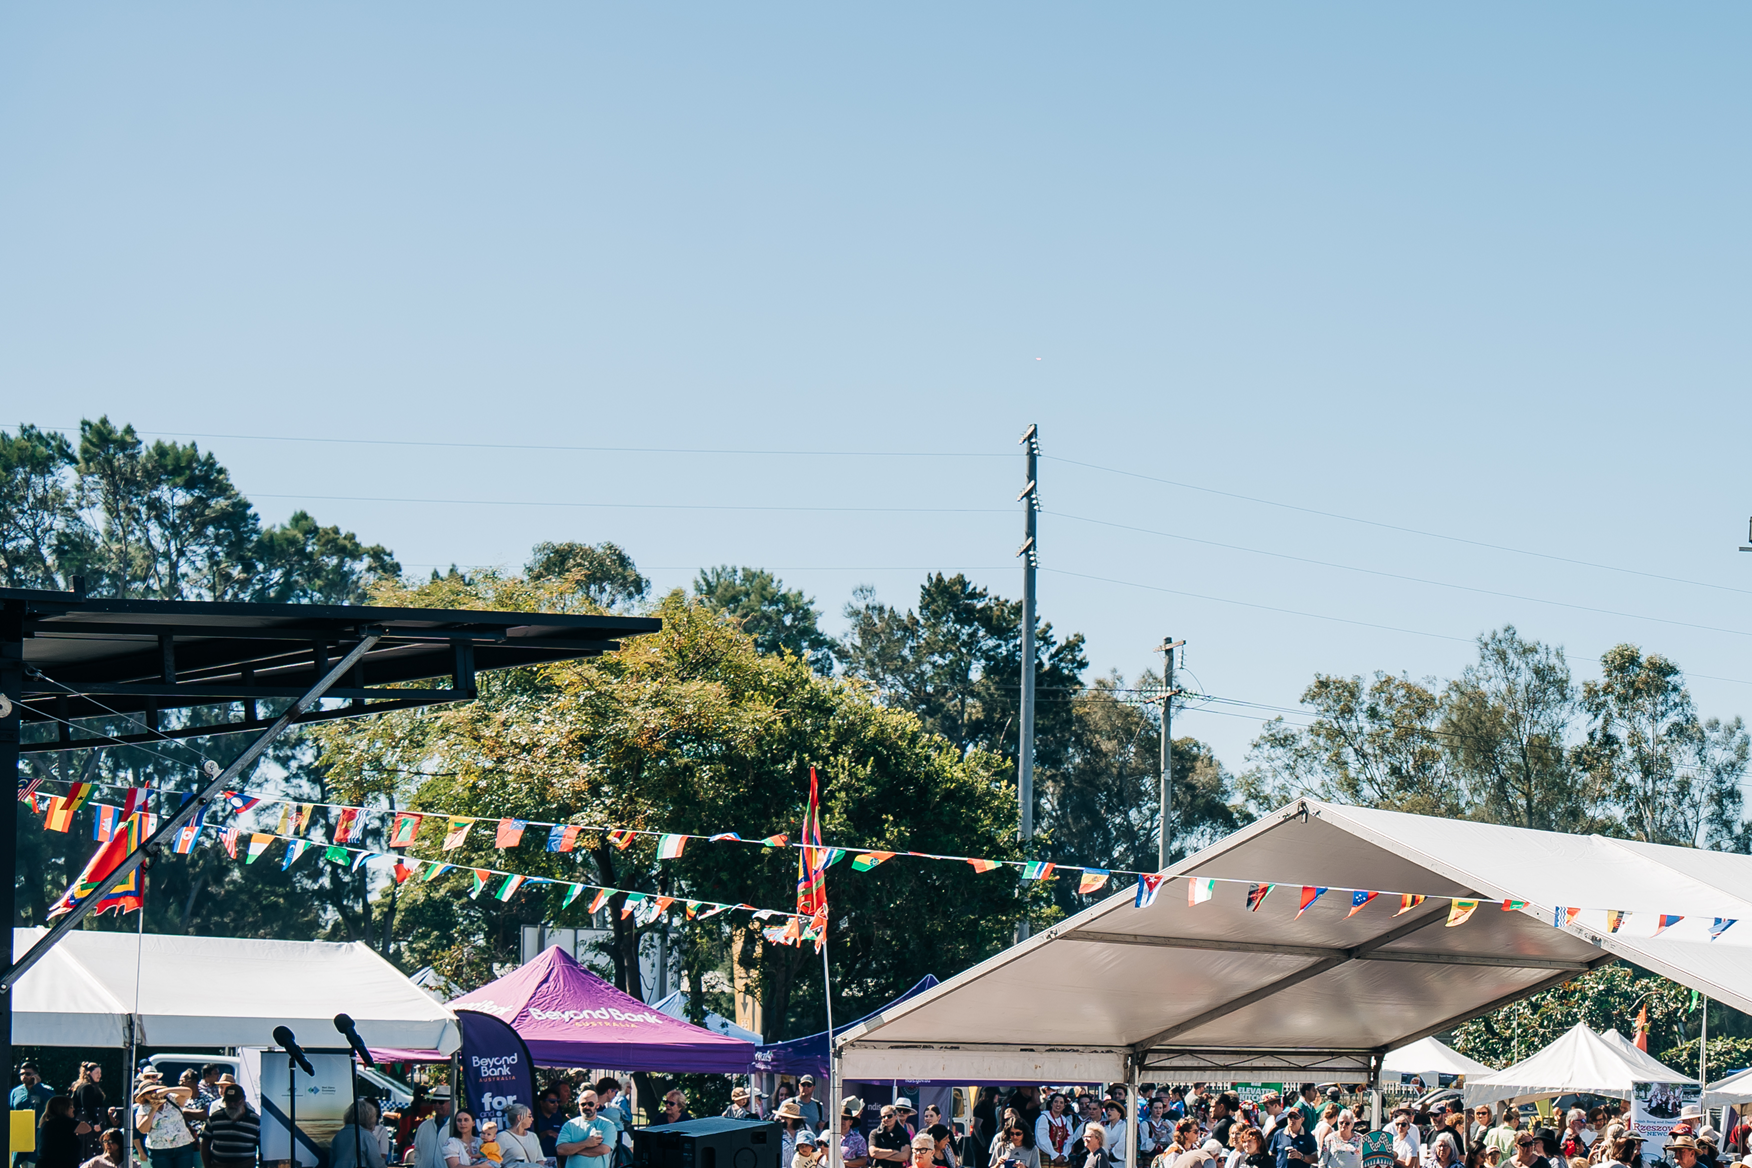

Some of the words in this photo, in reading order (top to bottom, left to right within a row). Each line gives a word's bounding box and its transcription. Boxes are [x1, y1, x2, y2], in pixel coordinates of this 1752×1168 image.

[529, 1007, 610, 1023] Beyond
[608, 1008, 664, 1025] Bank
[574, 1020, 638, 1029] AUSTRALIA
[471, 1052, 518, 1068] Beyond
[480, 1064, 511, 1077] Bank
[478, 1075, 516, 1083] AUSTRALIA
[481, 1091, 517, 1112] for
[480, 1110, 495, 1118] and
